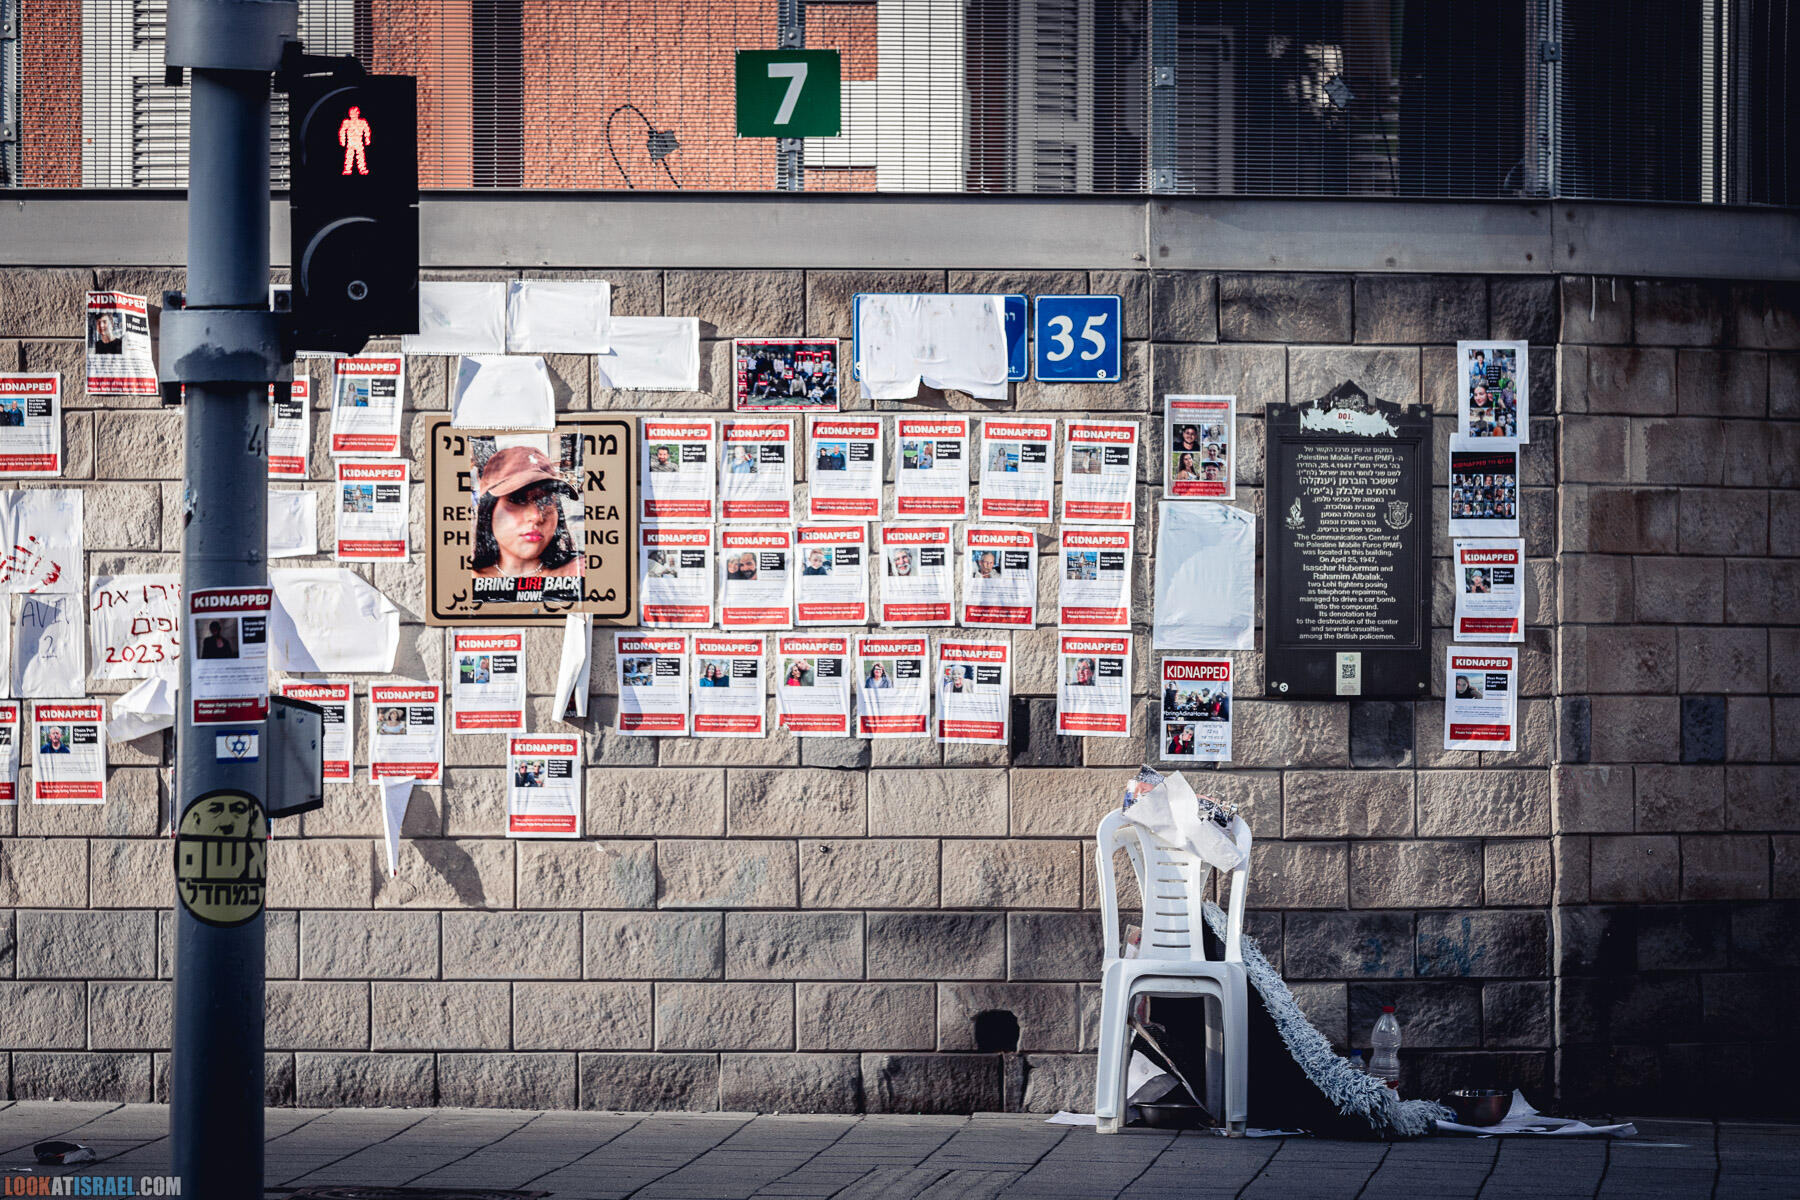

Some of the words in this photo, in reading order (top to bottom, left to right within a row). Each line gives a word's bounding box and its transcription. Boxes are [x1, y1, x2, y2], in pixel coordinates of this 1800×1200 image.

[767, 62, 808, 125] 7
[88, 294, 146, 309] KIDNAPPED
[1046, 312, 1108, 362] 35
[338, 363, 397, 372] KIDNAPPED
[649, 428, 708, 438] KIDNAPPED
[727, 429, 785, 439] KIDNAPPED
[816, 426, 875, 437] KIDNAPPED
[903, 425, 961, 435] KIDNAPPED
[988, 427, 1047, 438] KIDNAPPED
[1072, 429, 1131, 440] KIDNAPPED
[343, 469, 401, 477] KIDNAPPED
[1338, 477, 1368, 486] הוברמן
[1370, 477, 1398, 486] יששכר
[1366, 486, 1396, 496] ורחמים
[584, 505, 620, 521] REA
[647, 534, 707, 544] KIDNAPPED
[726, 536, 786, 546] KIDNAPPED
[802, 531, 860, 542] KIDNAPPED
[887, 532, 945, 541] KIDNAPPED
[971, 535, 1030, 545] KIDNAPPED
[1066, 536, 1125, 546] KIDNAPPED
[1318, 549, 1342, 557] located
[1352, 549, 1364, 557] this
[1464, 553, 1515, 562] KIDNAPPED
[474, 577, 515, 592] BRING
[517, 577, 543, 590] LIRI
[544, 577, 580, 591] BACK
[93, 590, 129, 611] את
[193, 592, 269, 609] KIDNAPPED
[516, 590, 543, 602] NOW!
[458, 639, 518, 649] KIDNAPPED
[622, 642, 681, 651] KIDNAPPED
[699, 643, 758, 653] KIDNAPPED
[783, 642, 843, 652] KIDNAPPED
[863, 644, 922, 654] KIDNAPPED
[1065, 641, 1124, 652] KIDNAPPED
[106, 643, 165, 664] 2023
[944, 648, 1003, 659] KIDNAPPED
[1456, 658, 1509, 667] KIDNAPPED
[1166, 665, 1228, 679] KIDNAPPED
[287, 688, 346, 698] KIDNAPPED
[375, 691, 435, 700] KIDNAPPED
[39, 709, 98, 719] KIDNAPPED
[514, 743, 574, 753] KIDNAPPED
[179, 841, 266, 879] אשם
[186, 878, 260, 905] במחדל
